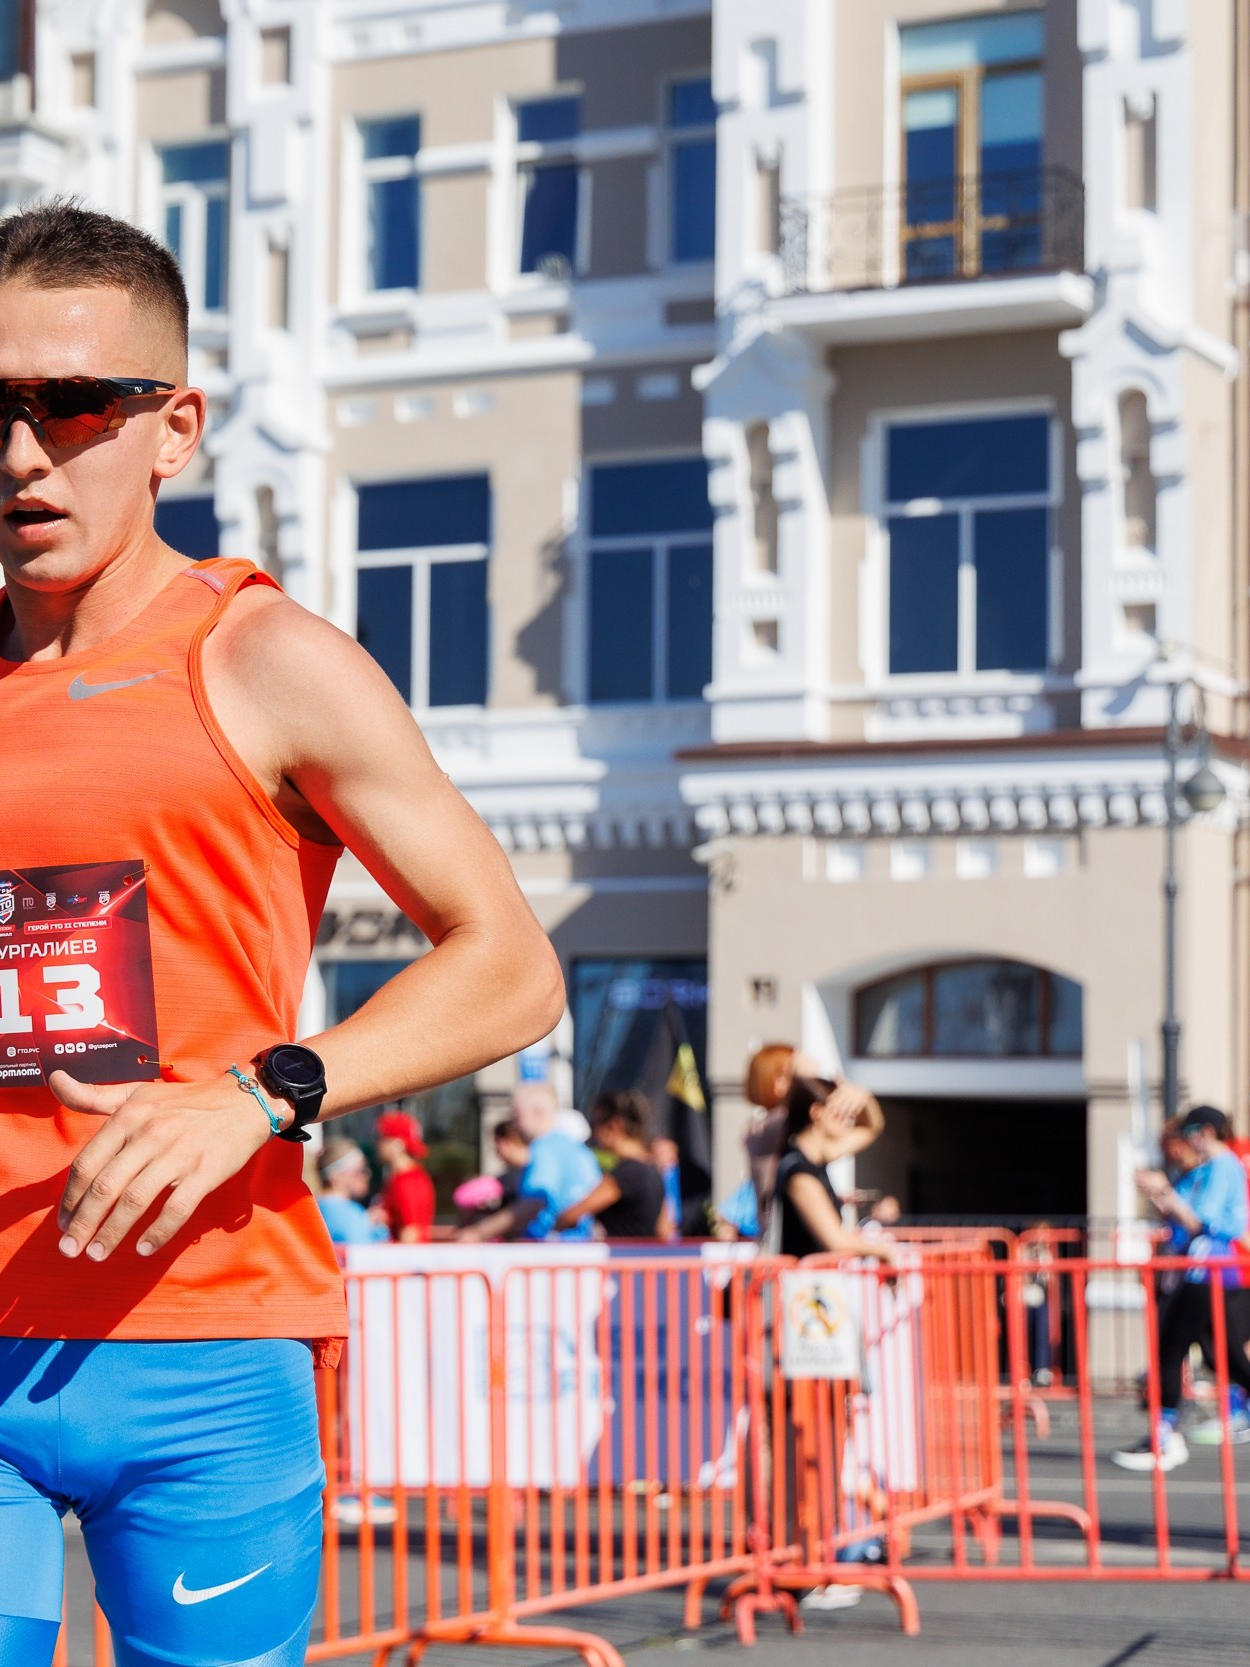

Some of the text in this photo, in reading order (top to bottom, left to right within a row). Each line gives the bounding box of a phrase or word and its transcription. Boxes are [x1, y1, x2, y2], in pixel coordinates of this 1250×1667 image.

[27, 923, 49, 932] ГЕРОЙ
[50, 922, 63, 930] ГТО
[73, 920, 107, 928] СТЕПЕНИ
[87, 1042, 118, 1051] @gtosport
